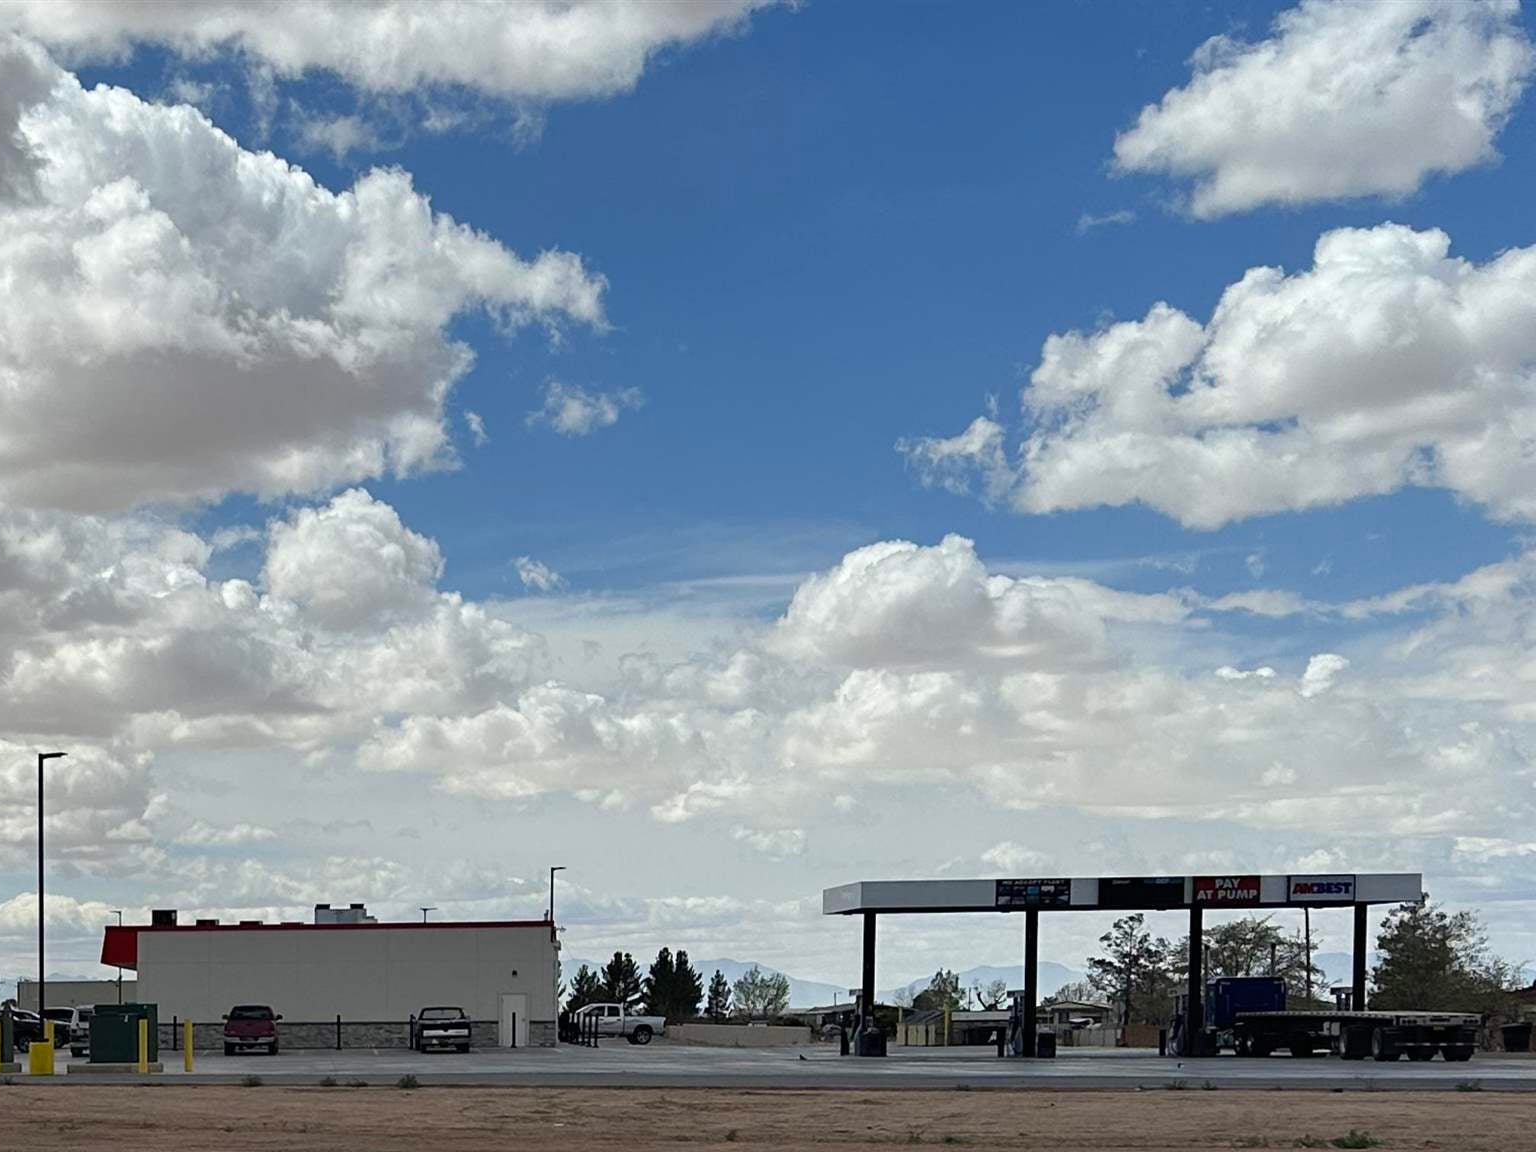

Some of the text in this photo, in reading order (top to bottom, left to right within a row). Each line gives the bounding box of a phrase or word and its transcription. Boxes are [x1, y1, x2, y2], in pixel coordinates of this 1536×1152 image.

[1215, 878, 1241, 888] PAY
[1197, 889, 1258, 900] AT PUMP
